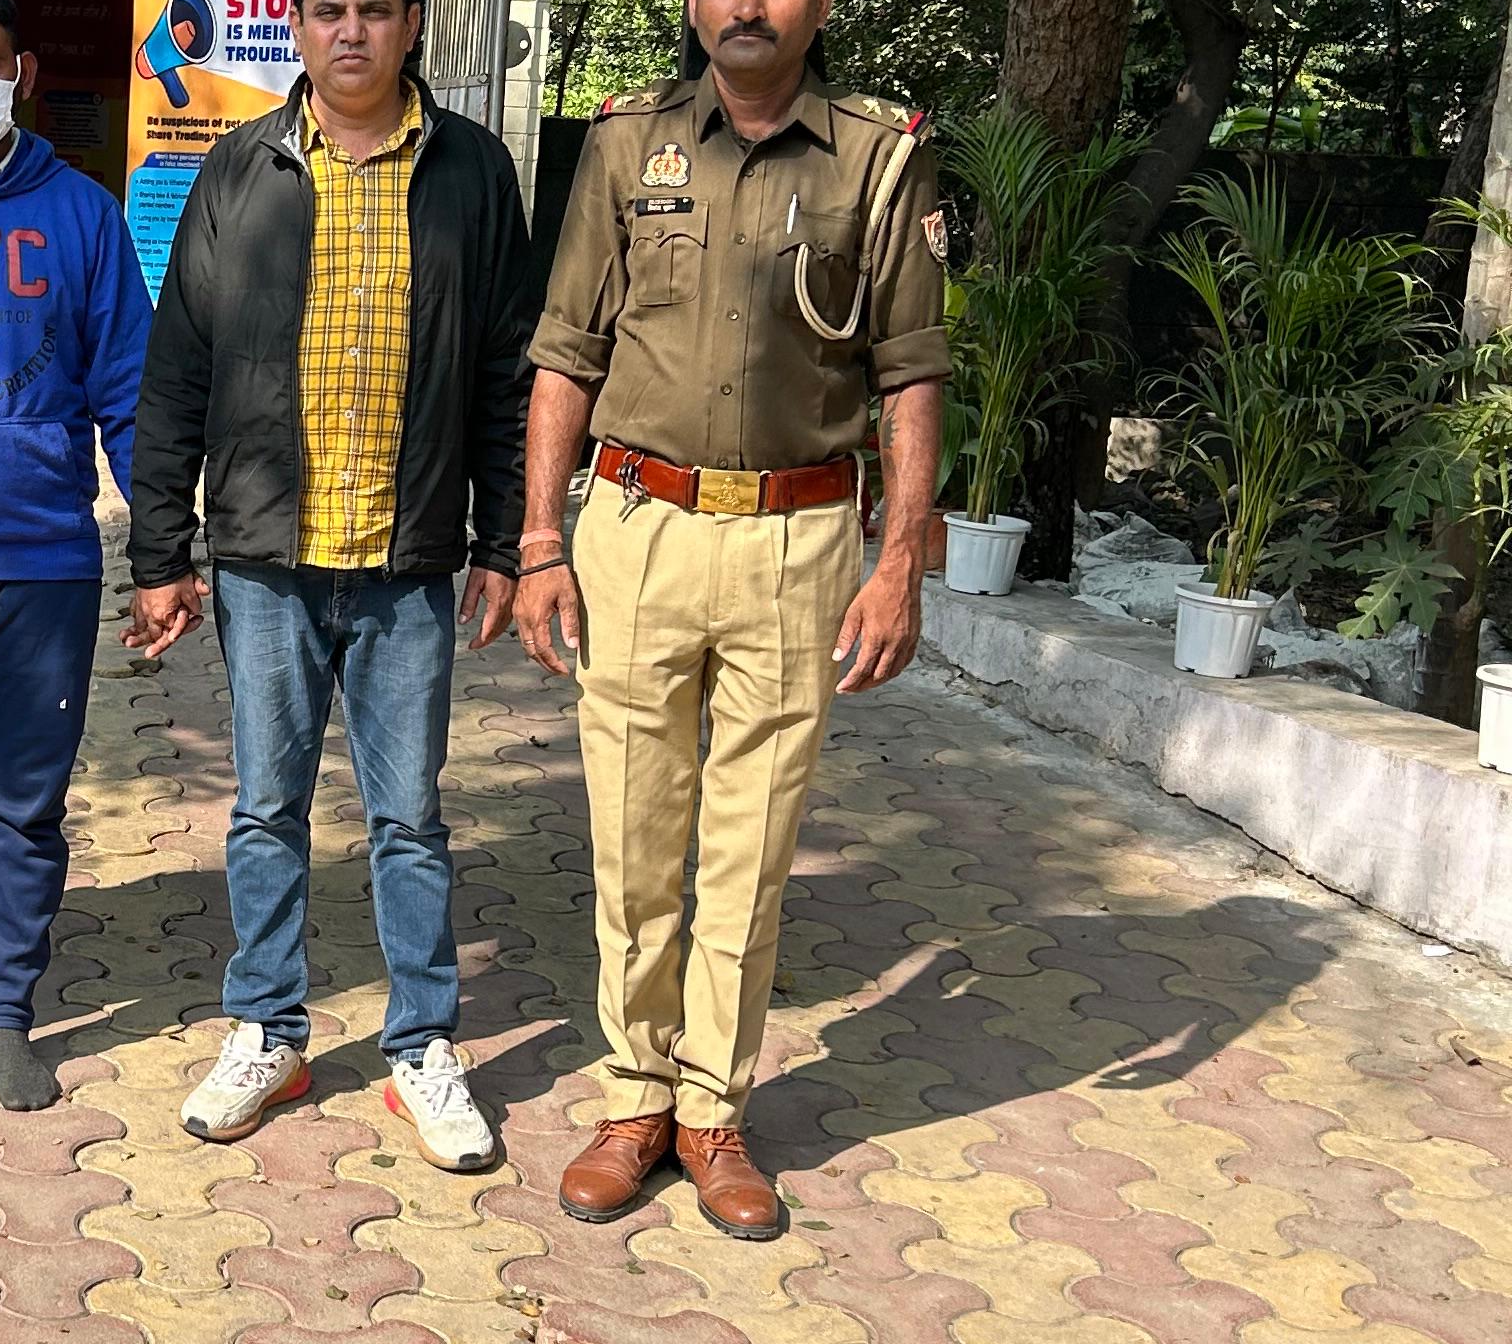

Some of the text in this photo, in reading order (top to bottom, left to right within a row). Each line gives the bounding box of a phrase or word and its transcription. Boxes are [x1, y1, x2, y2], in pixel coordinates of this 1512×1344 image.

[226, 24, 291, 41] IS MEIN
[146, 116, 159, 126] Be
[161, 117, 210, 129] suspicious
[211, 117, 223, 127] of
[146, 130, 173, 140] Share
